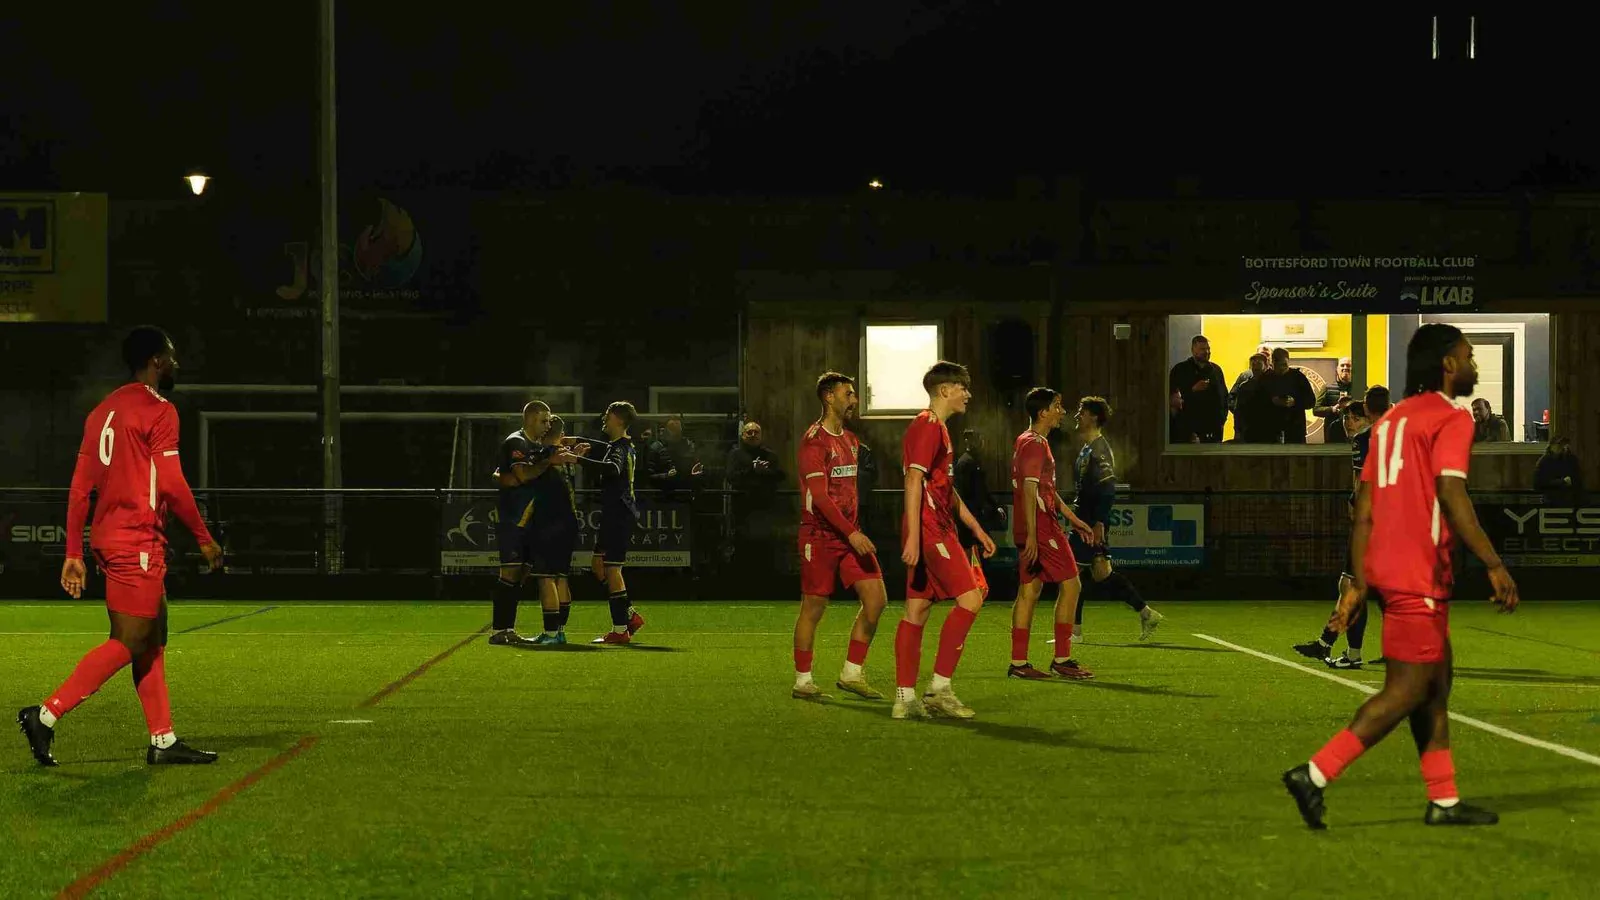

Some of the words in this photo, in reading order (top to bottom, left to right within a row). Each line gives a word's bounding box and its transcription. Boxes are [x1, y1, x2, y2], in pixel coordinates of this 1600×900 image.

[1245, 257, 1328, 269] BOTTESFORD
[1330, 257, 1370, 268] TOWN
[1374, 256, 1440, 268] FOOTBALL
[1442, 257, 1475, 268] CLUB
[1245, 280, 1331, 304] Sponsor's
[1331, 280, 1378, 300] Suite
[1420, 286, 1474, 306] LKAB
[99, 410, 116, 467] 6
[1376, 416, 1408, 488] 14
[1503, 508, 1600, 535] YES
